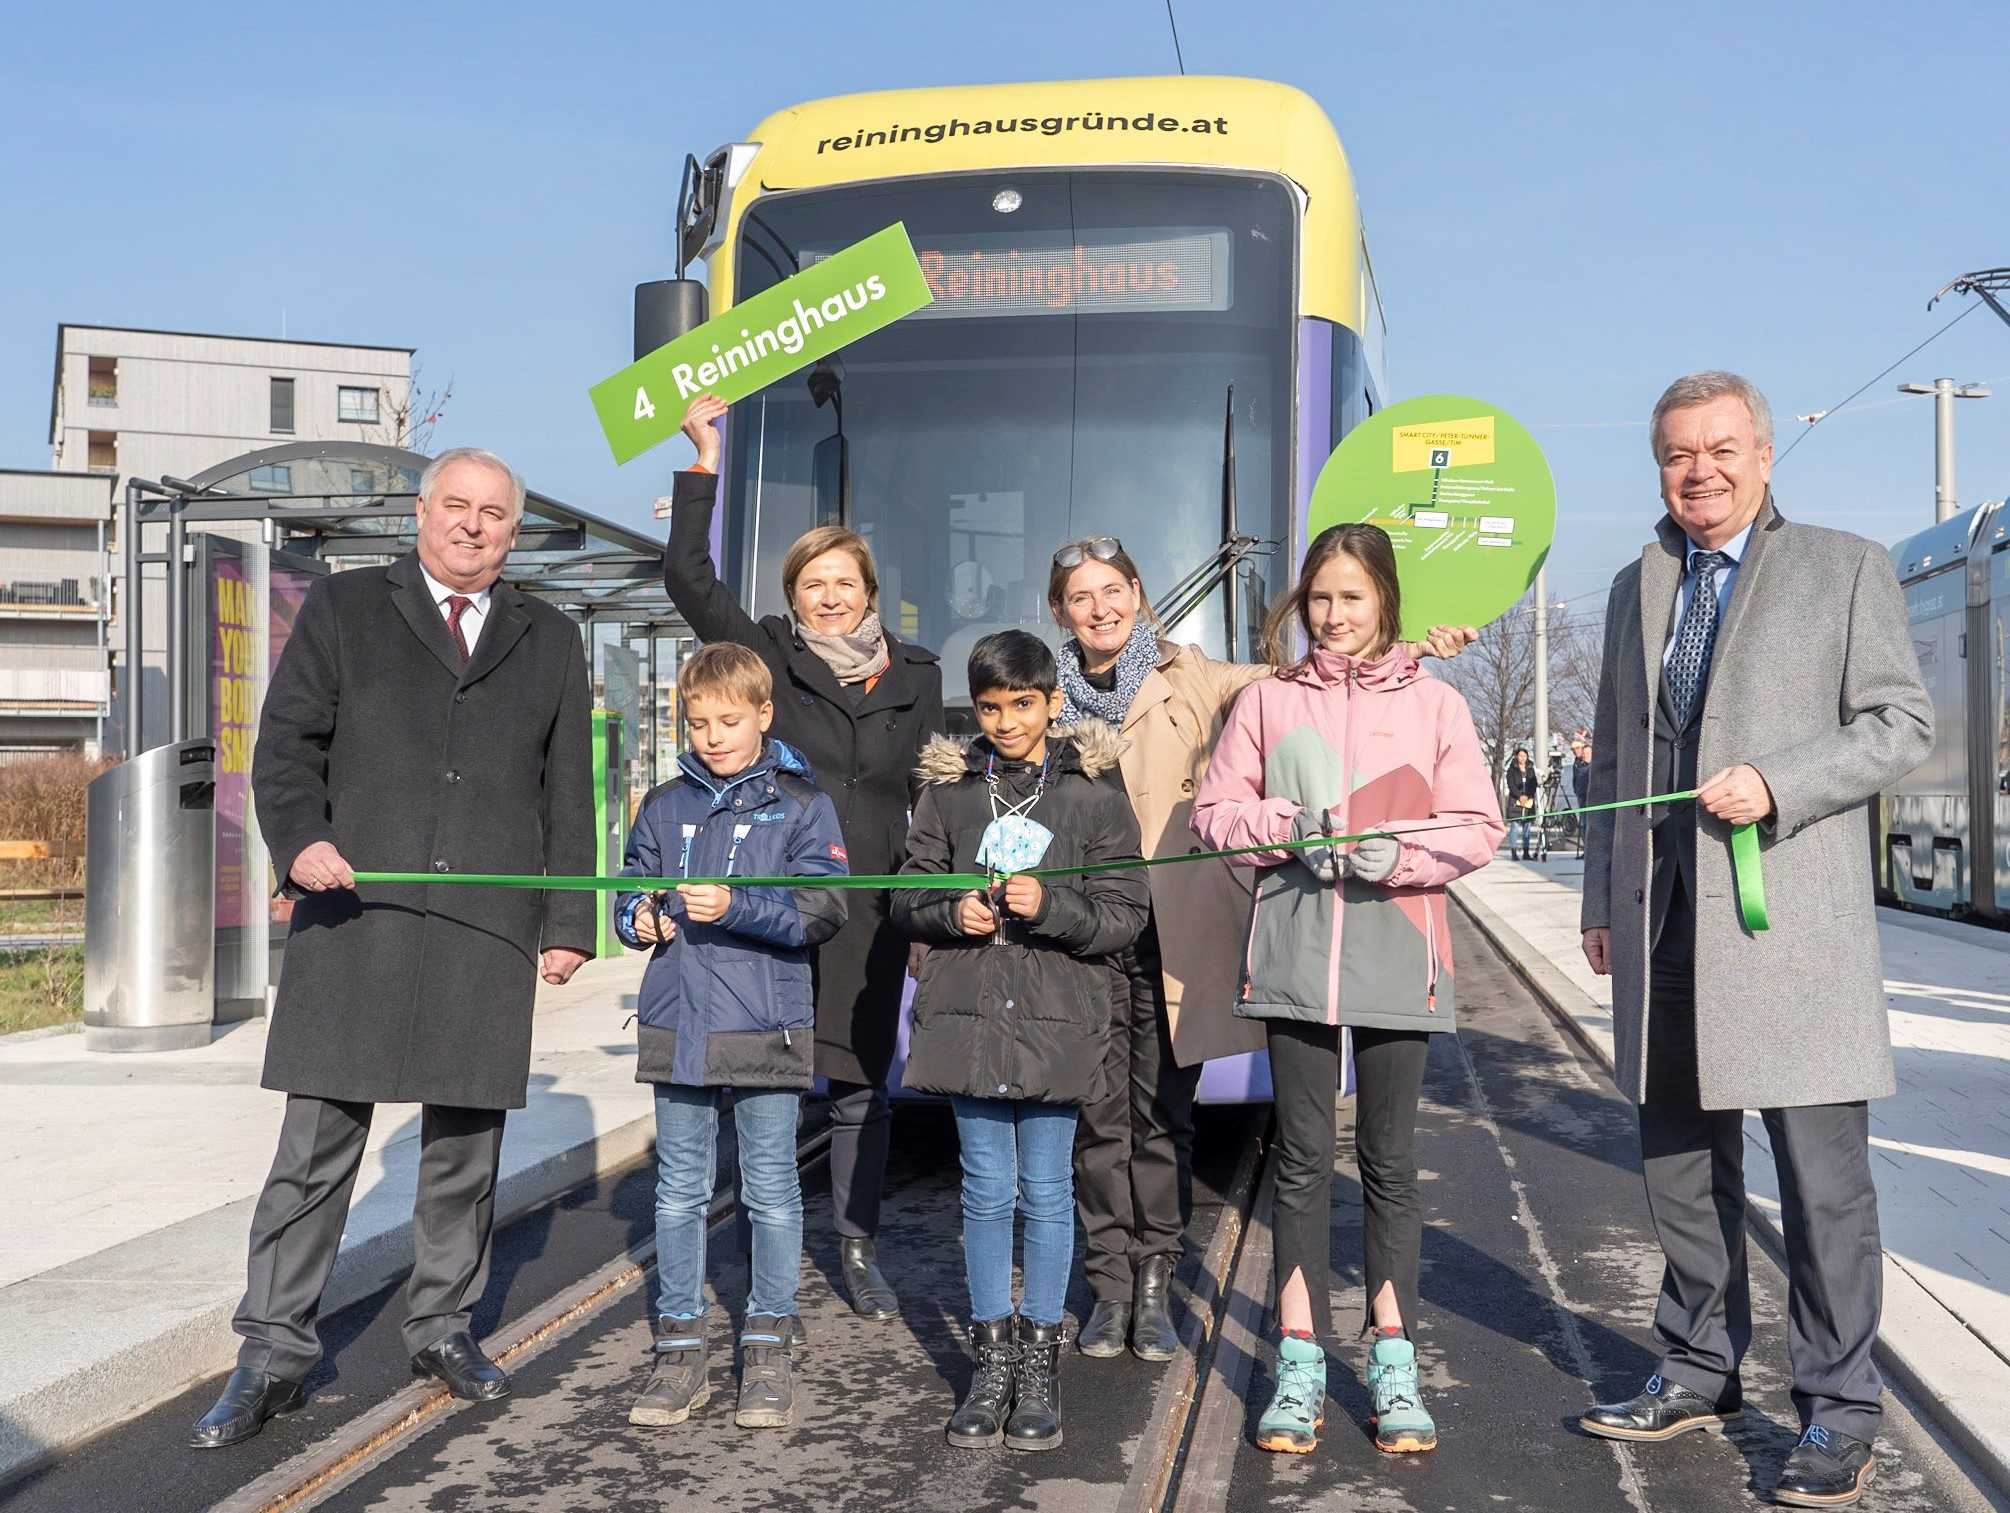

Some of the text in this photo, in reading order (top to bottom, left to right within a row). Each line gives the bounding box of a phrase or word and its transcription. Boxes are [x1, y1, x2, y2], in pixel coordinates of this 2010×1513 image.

[817, 112, 1228, 155] reininghausgründe.at
[921, 245, 1180, 307] Reininghaus
[633, 274, 886, 421] 4 Reininghaus
[1434, 452, 1445, 464] 6
